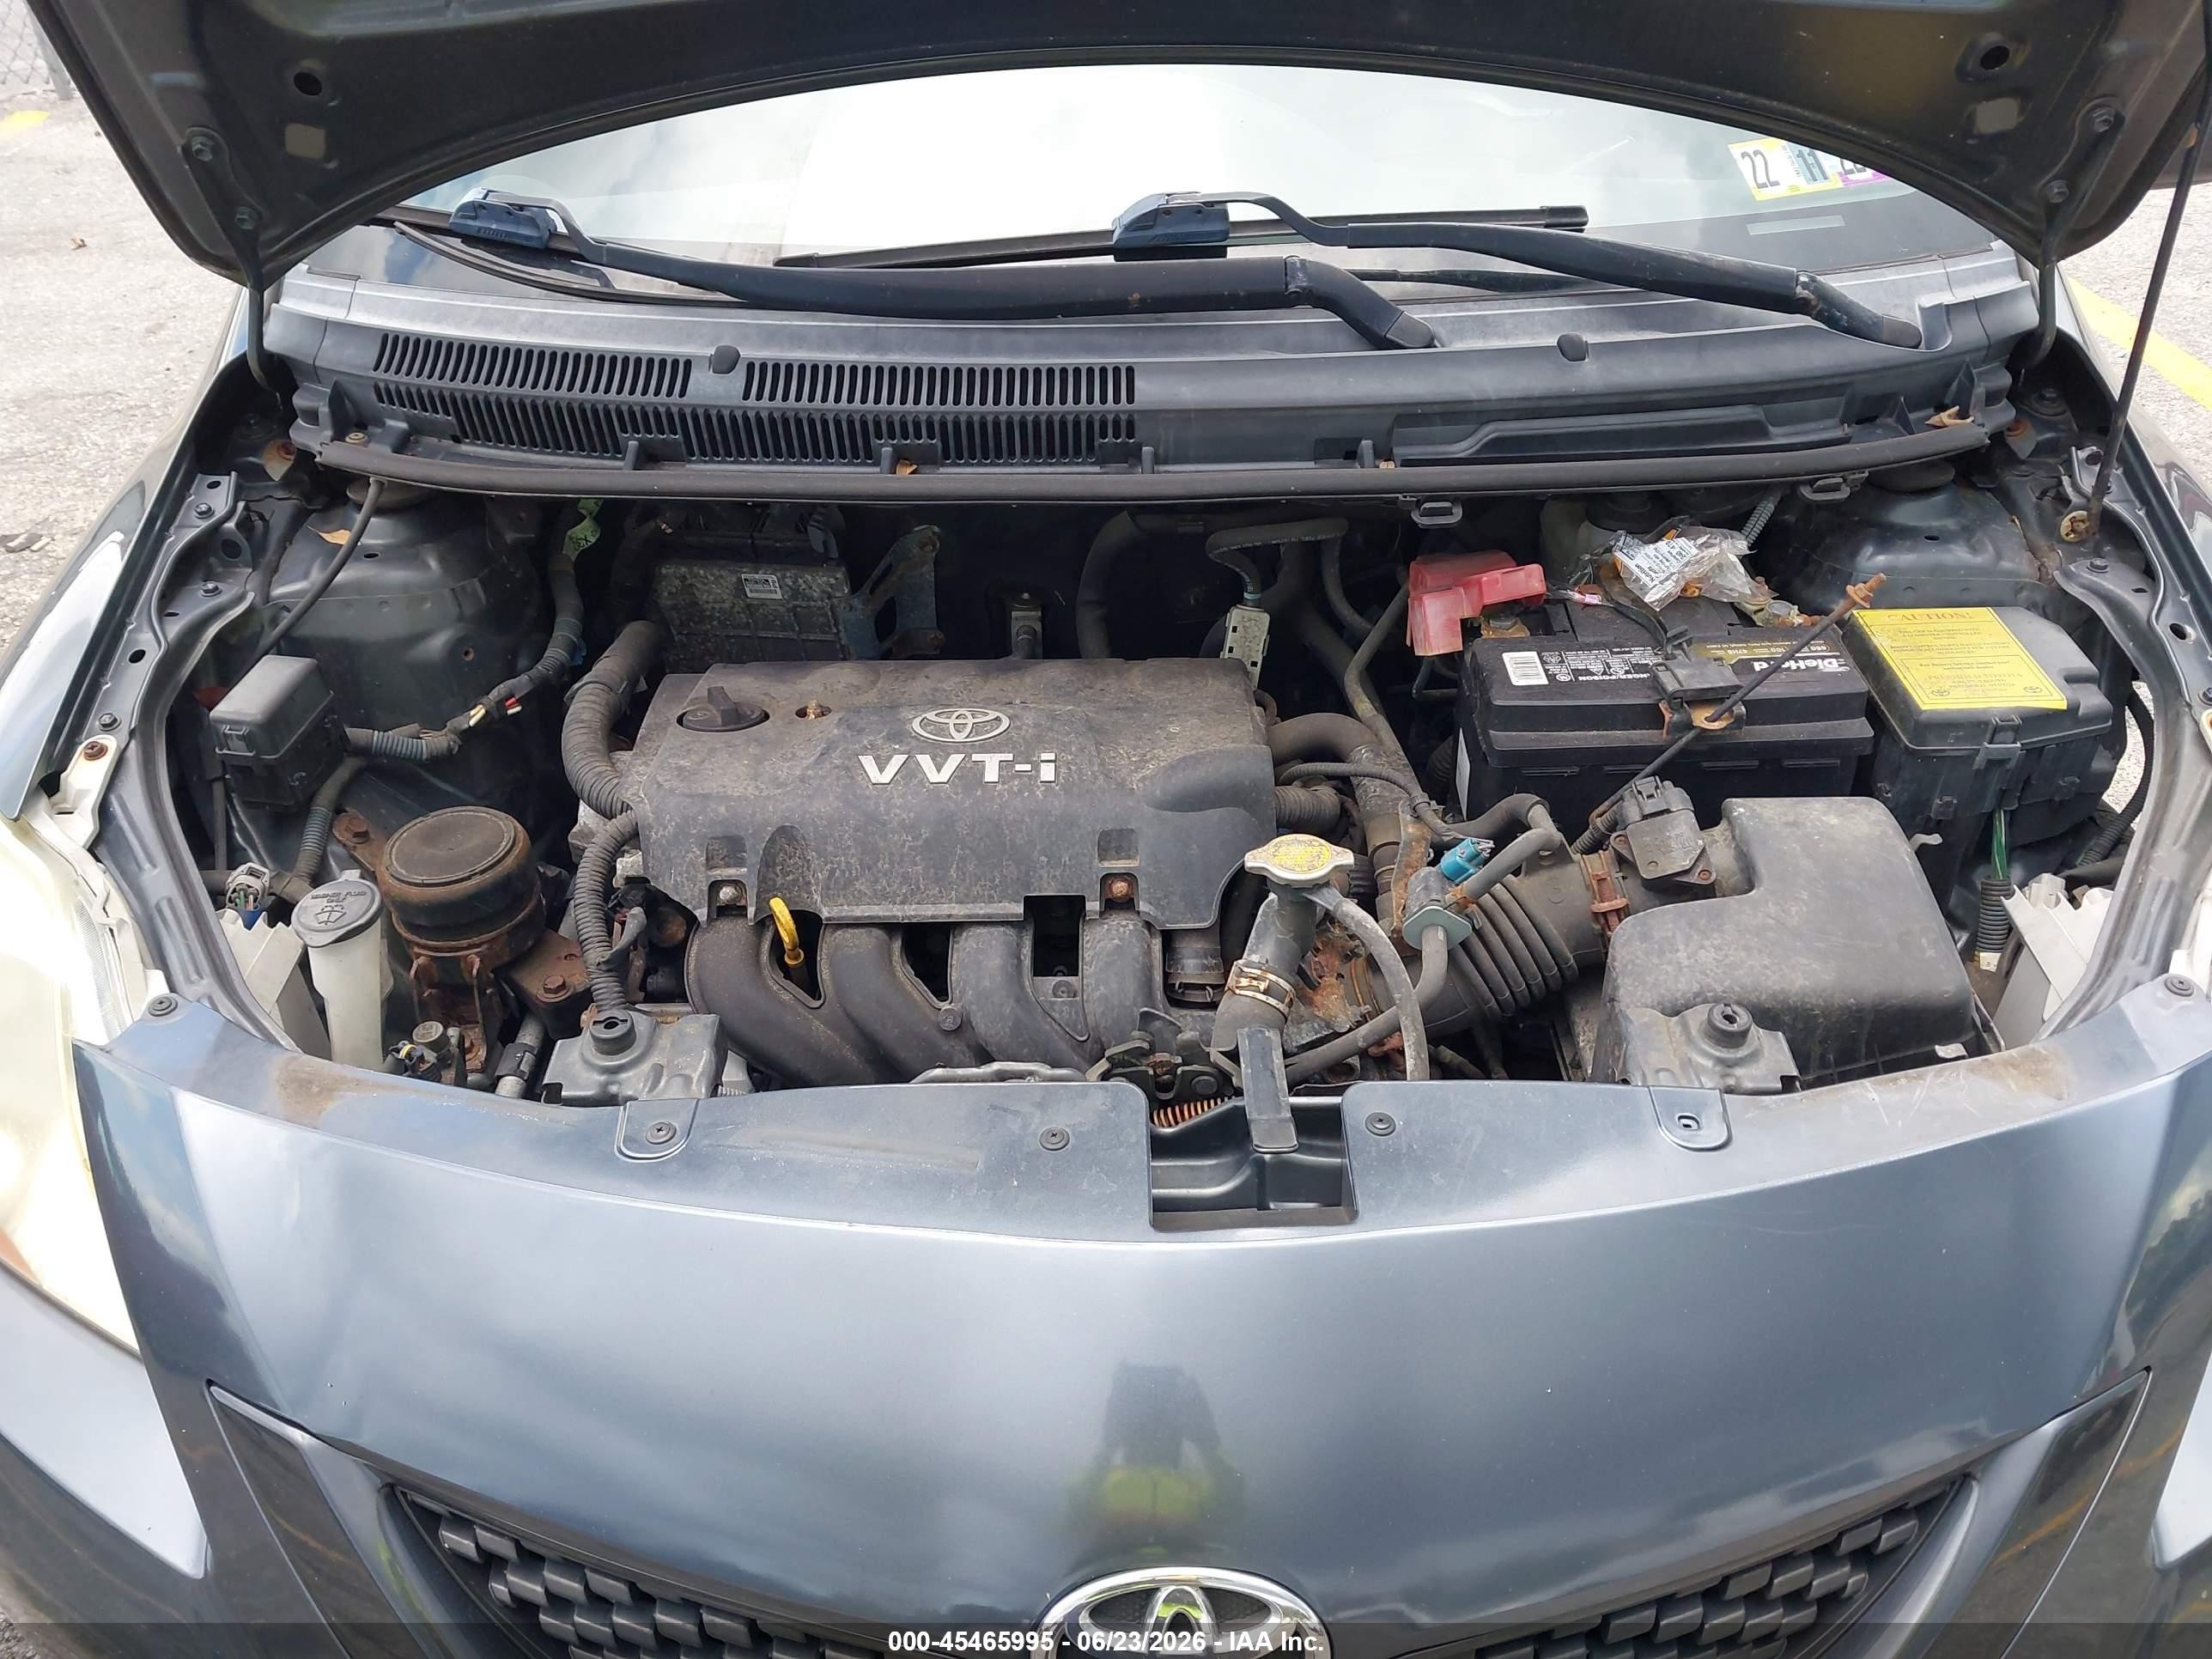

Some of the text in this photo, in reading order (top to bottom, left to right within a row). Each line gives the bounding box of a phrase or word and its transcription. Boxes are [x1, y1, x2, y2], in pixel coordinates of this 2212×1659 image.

[1741, 149, 1781, 189] 22
[1796, 149, 1829, 183] 11
[1635, 562, 1656, 583] Nutrition
[1886, 611, 1973, 622] CAUTION!
[1753, 658, 1841, 672] DieHd
[1577, 672, 1650, 681] NGER/POISON
[858, 750, 1057, 786] VVT-i
